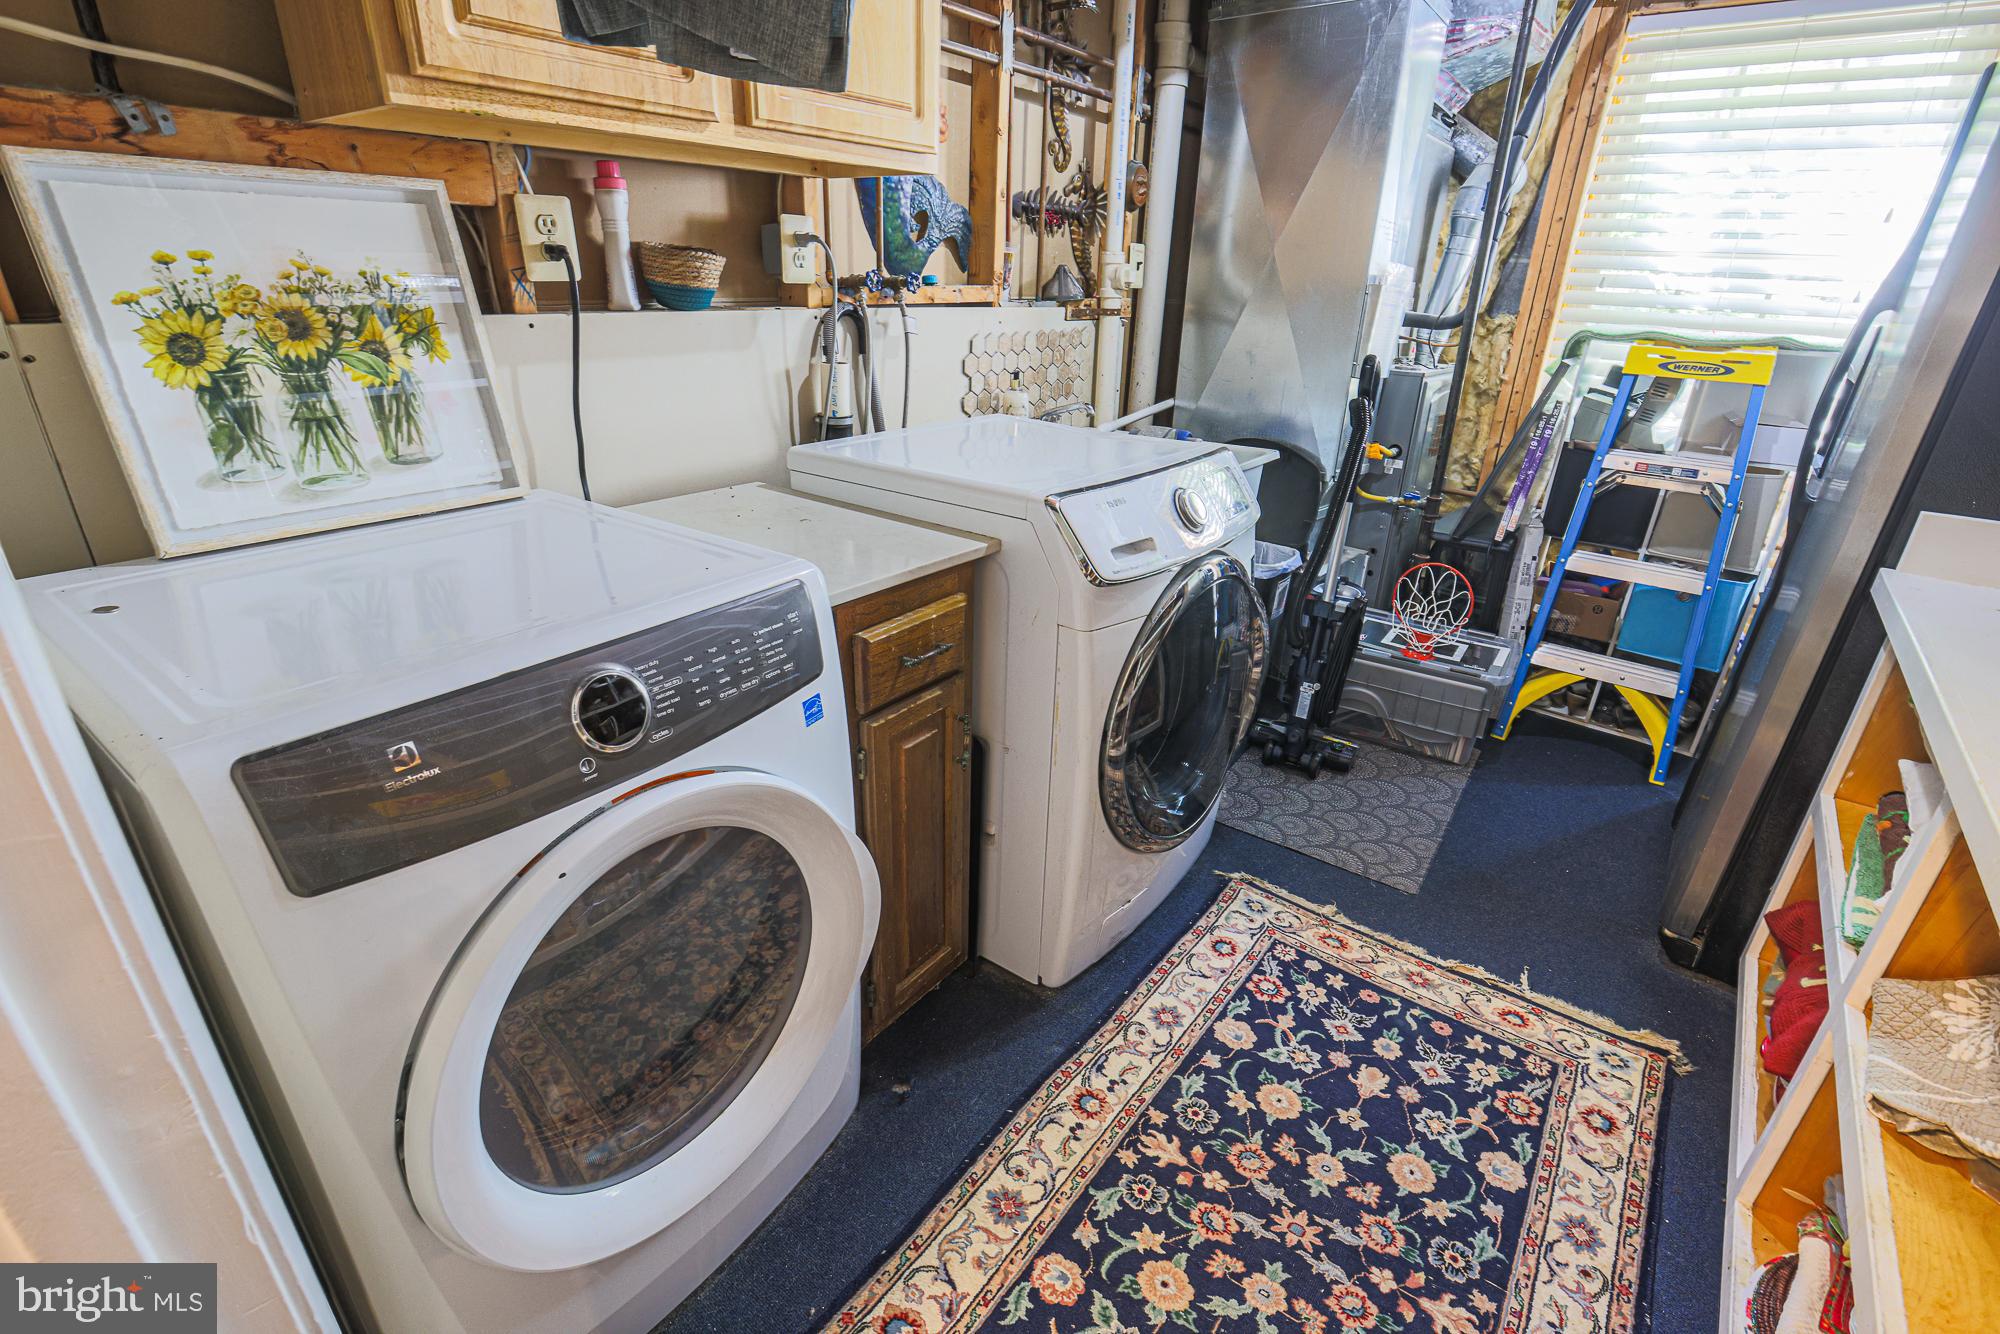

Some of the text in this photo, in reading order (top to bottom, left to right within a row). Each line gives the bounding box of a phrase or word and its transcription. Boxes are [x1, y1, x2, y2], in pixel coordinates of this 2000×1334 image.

[1673, 363, 1721, 374] WERNER
[712, 654, 727, 663] normal
[648, 660, 659, 668] duty
[688, 664, 703, 673] normal
[641, 669, 657, 677] towels
[765, 669, 781, 679] options
[648, 675, 664, 683] normal
[720, 688, 737, 698] dryness
[698, 698, 711, 707] temp
[652, 729, 670, 740] cycles
[384, 767, 441, 792] Electrolux
